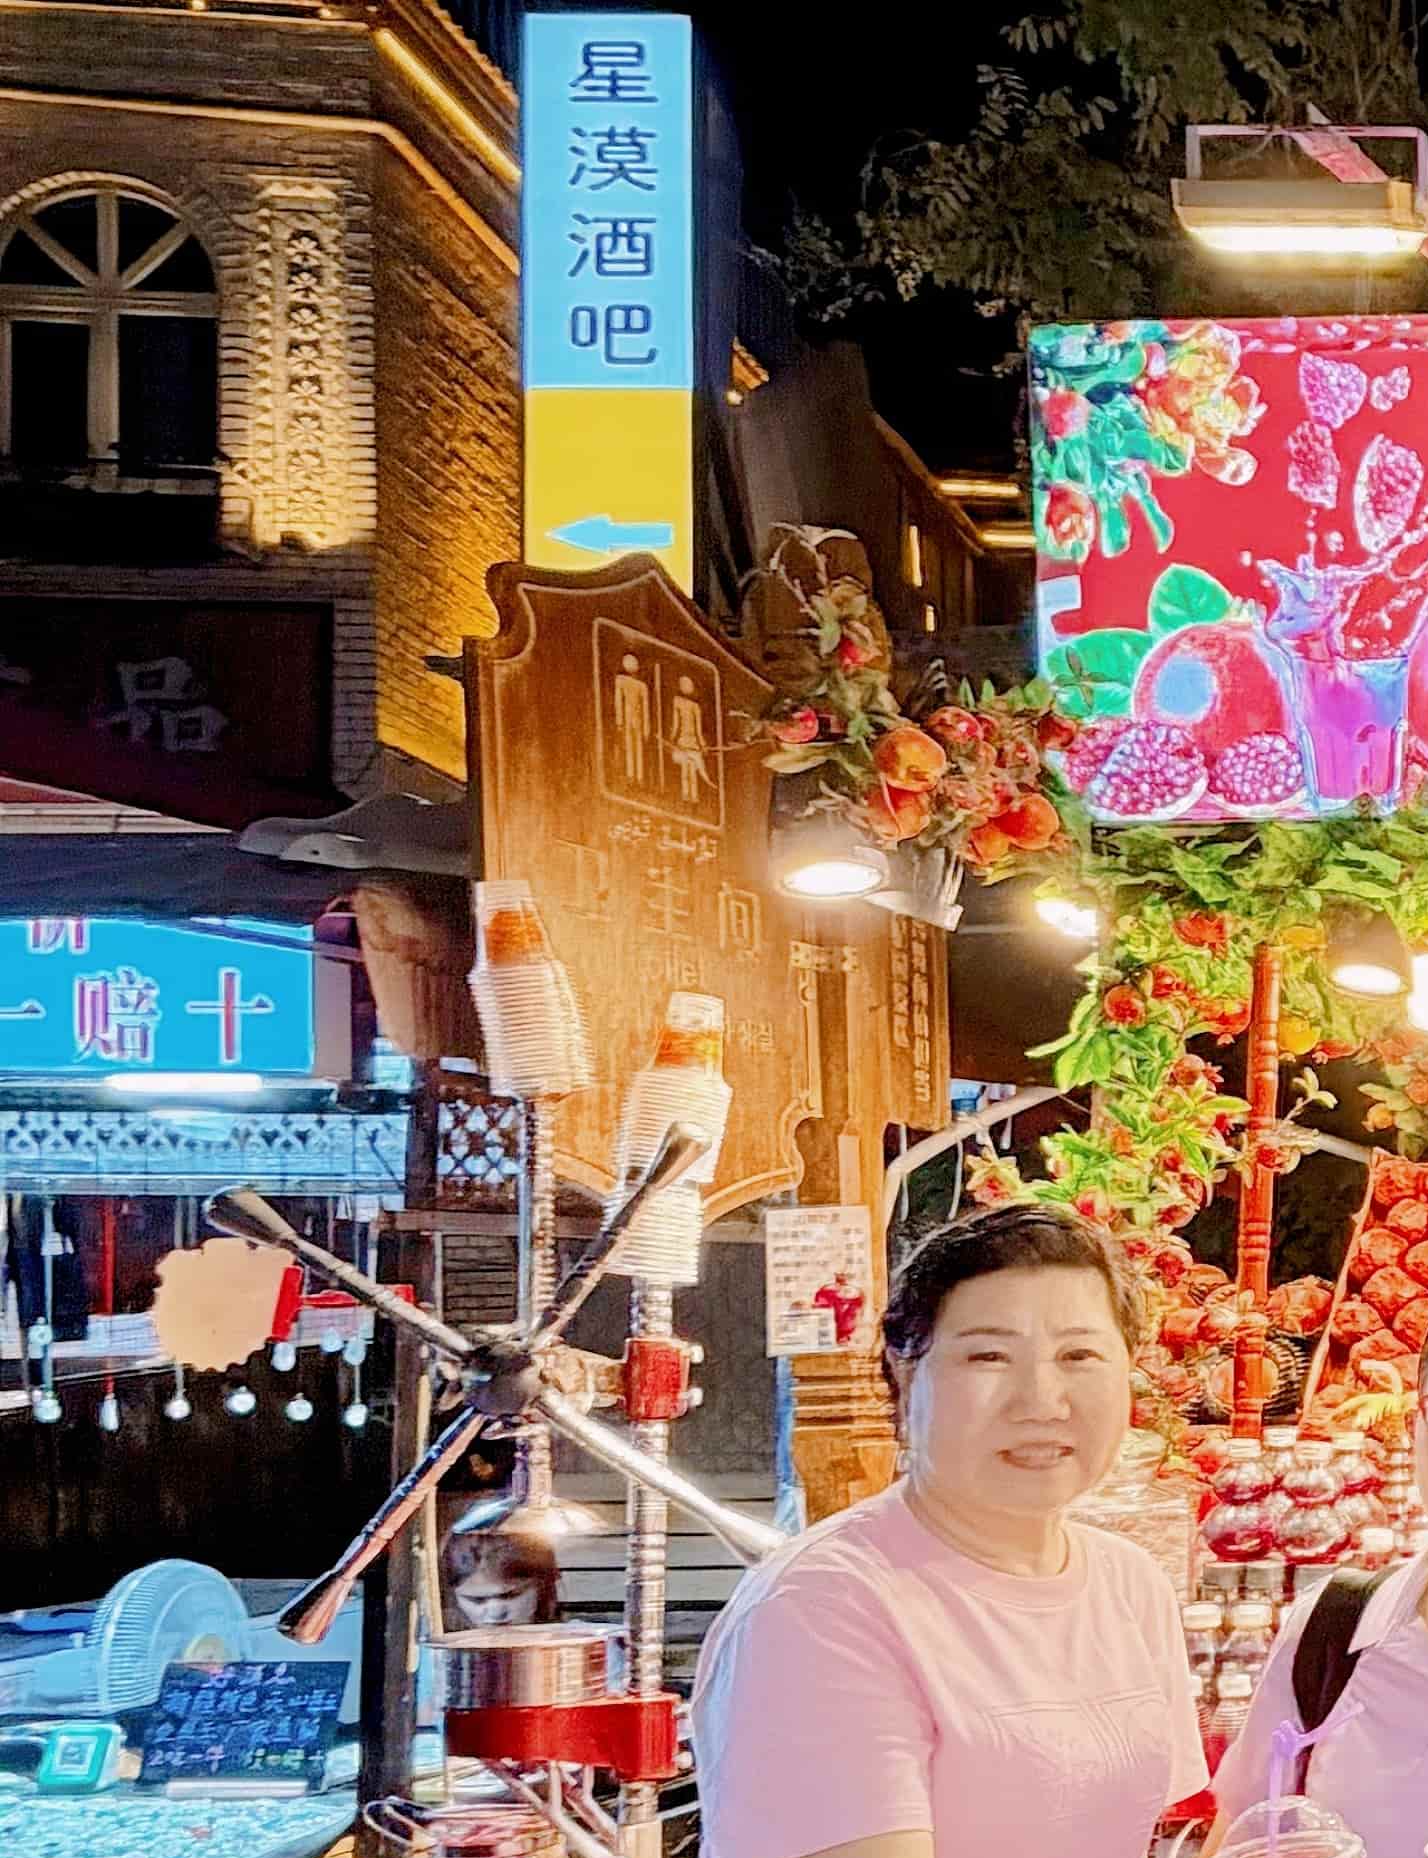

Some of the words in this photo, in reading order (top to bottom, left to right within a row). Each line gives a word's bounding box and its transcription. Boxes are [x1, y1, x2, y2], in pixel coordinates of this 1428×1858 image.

[567, 40, 660, 369] 星漠酒吧
[98, 655, 229, 752] 品
